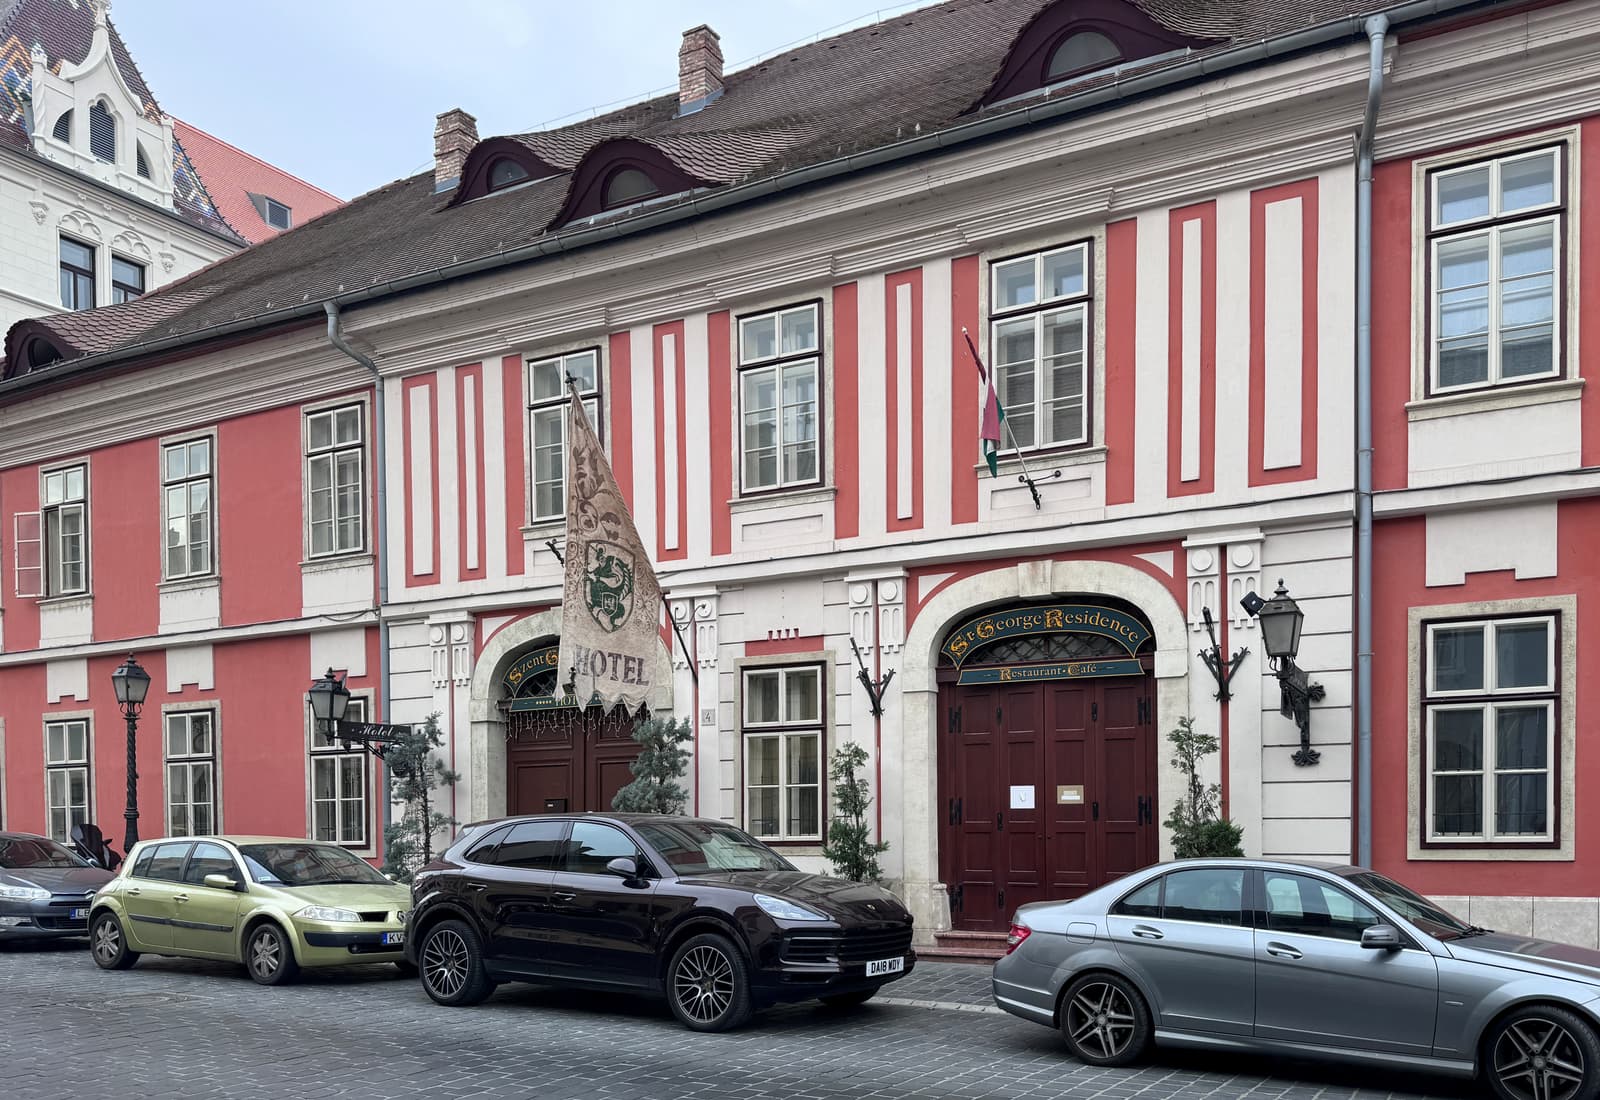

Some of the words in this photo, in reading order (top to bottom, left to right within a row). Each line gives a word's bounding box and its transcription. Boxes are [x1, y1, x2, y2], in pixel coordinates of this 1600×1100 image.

[951, 632, 976, 657] St
[976, 614, 1041, 639] George
[1043, 609, 1139, 643] Residence
[509, 656, 545, 685] Szent
[576, 644, 649, 686] HOTEL
[1000, 667, 1061, 680] Restaurant
[361, 724, 394, 736] Hotel
[871, 961, 887, 973] DA18
